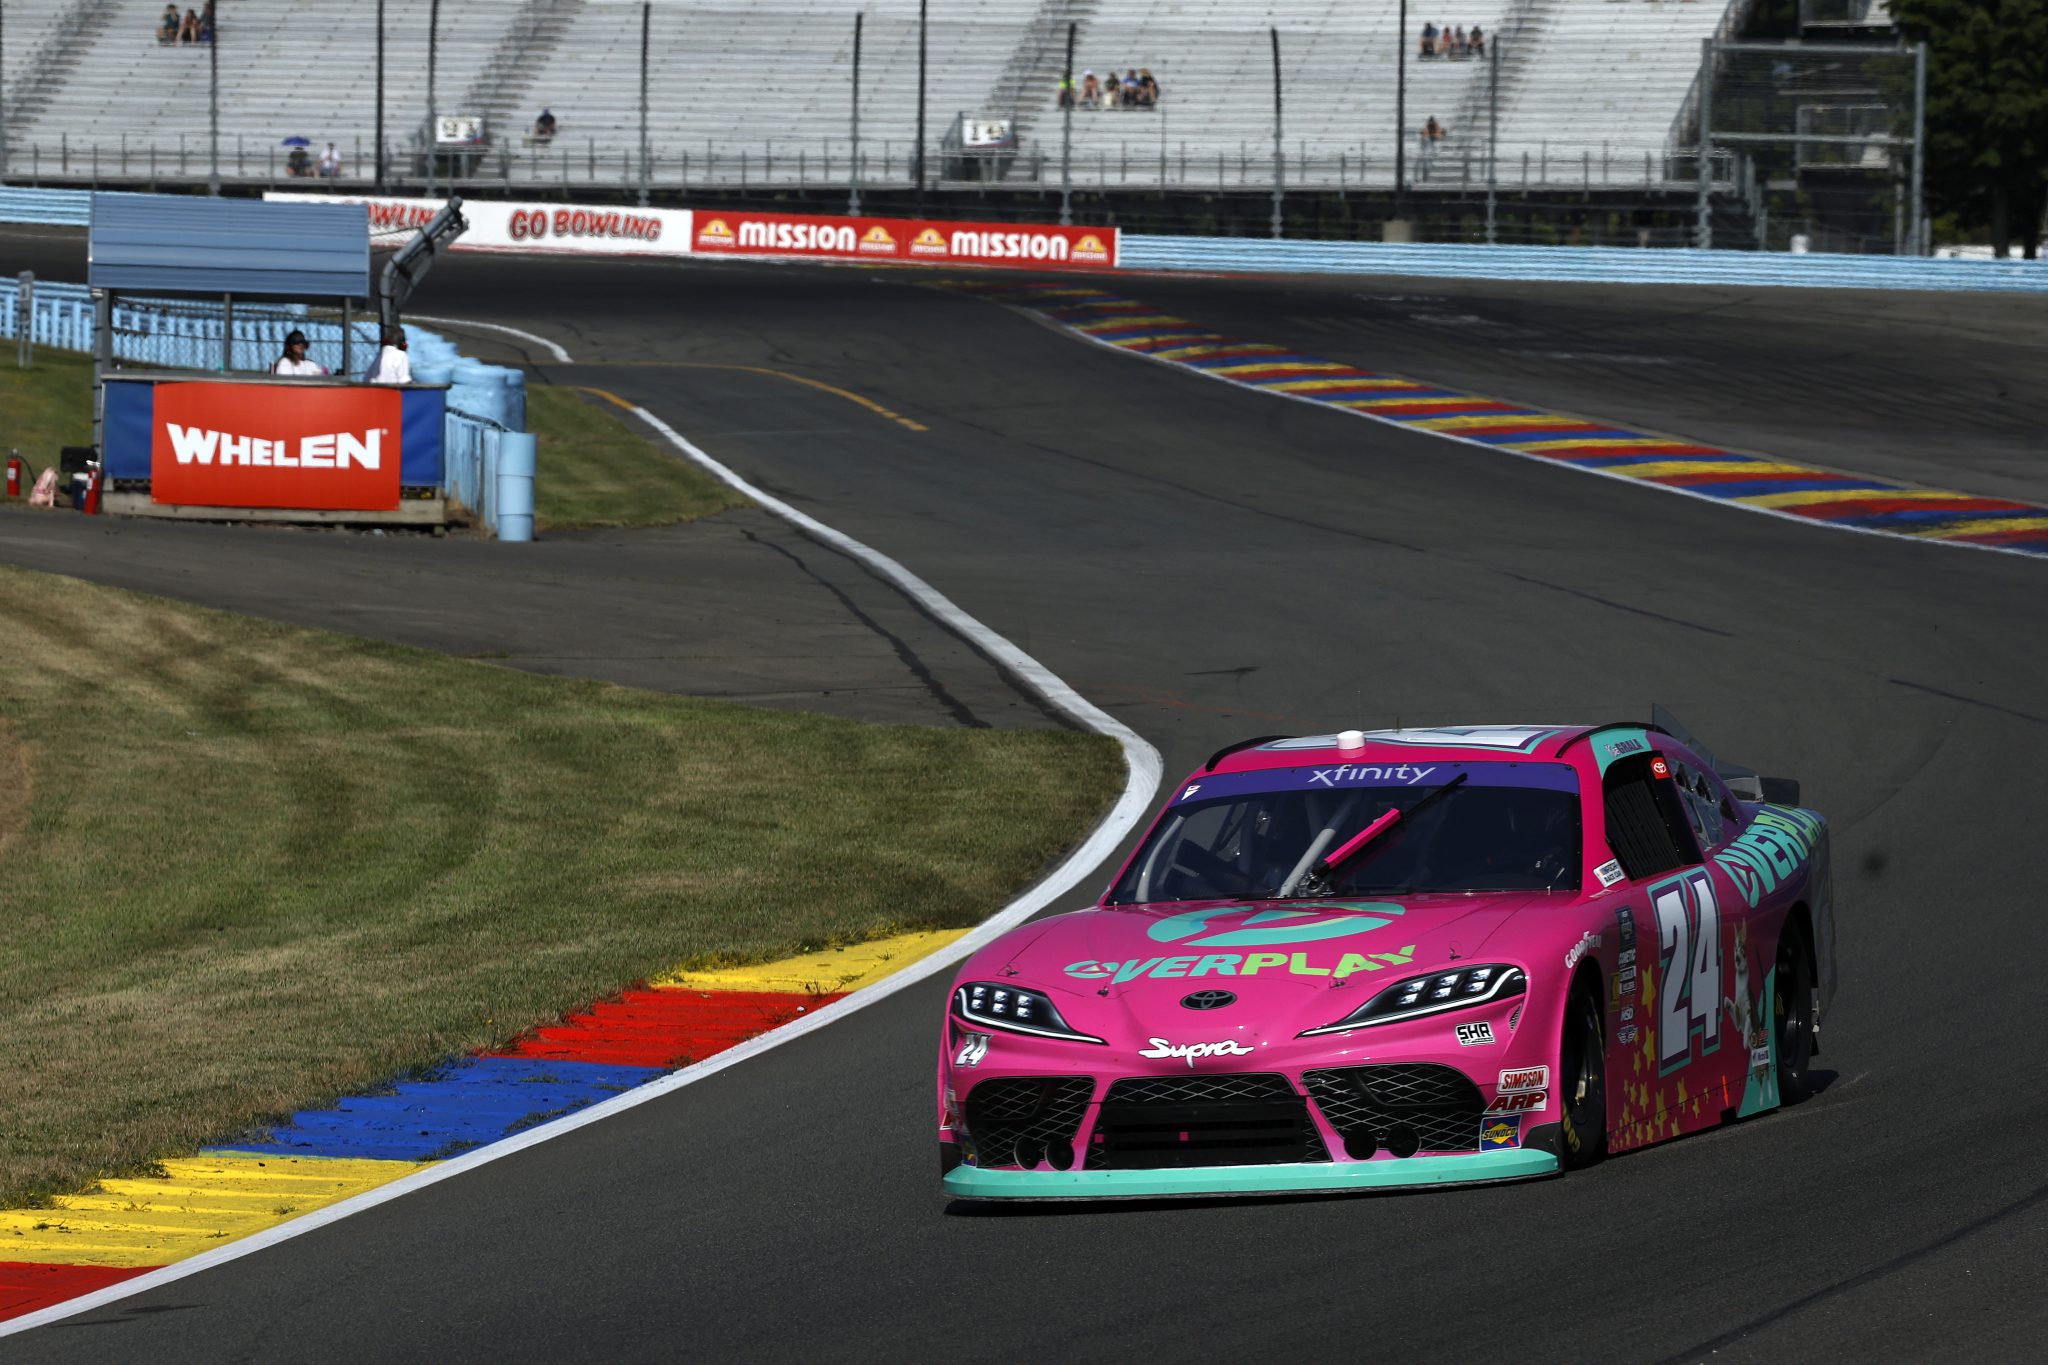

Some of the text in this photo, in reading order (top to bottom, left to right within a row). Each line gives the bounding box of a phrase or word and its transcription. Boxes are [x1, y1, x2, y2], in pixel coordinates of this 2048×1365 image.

[509, 208, 662, 241] GO BOWLING
[165, 421, 380, 470] WHELEN
[1307, 763, 1437, 787] xfinity
[1064, 944, 1414, 984] OVERPLAY
[1653, 871, 1721, 1069] 24
[1457, 1023, 1491, 1040] SHR
[955, 1033, 991, 1066] 24
[1138, 1037, 1255, 1068] Supra
[1502, 1070, 1544, 1090] SIMPSON
[1487, 1092, 1546, 1112] ARP
[1483, 1126, 1517, 1139] SUNOCO
